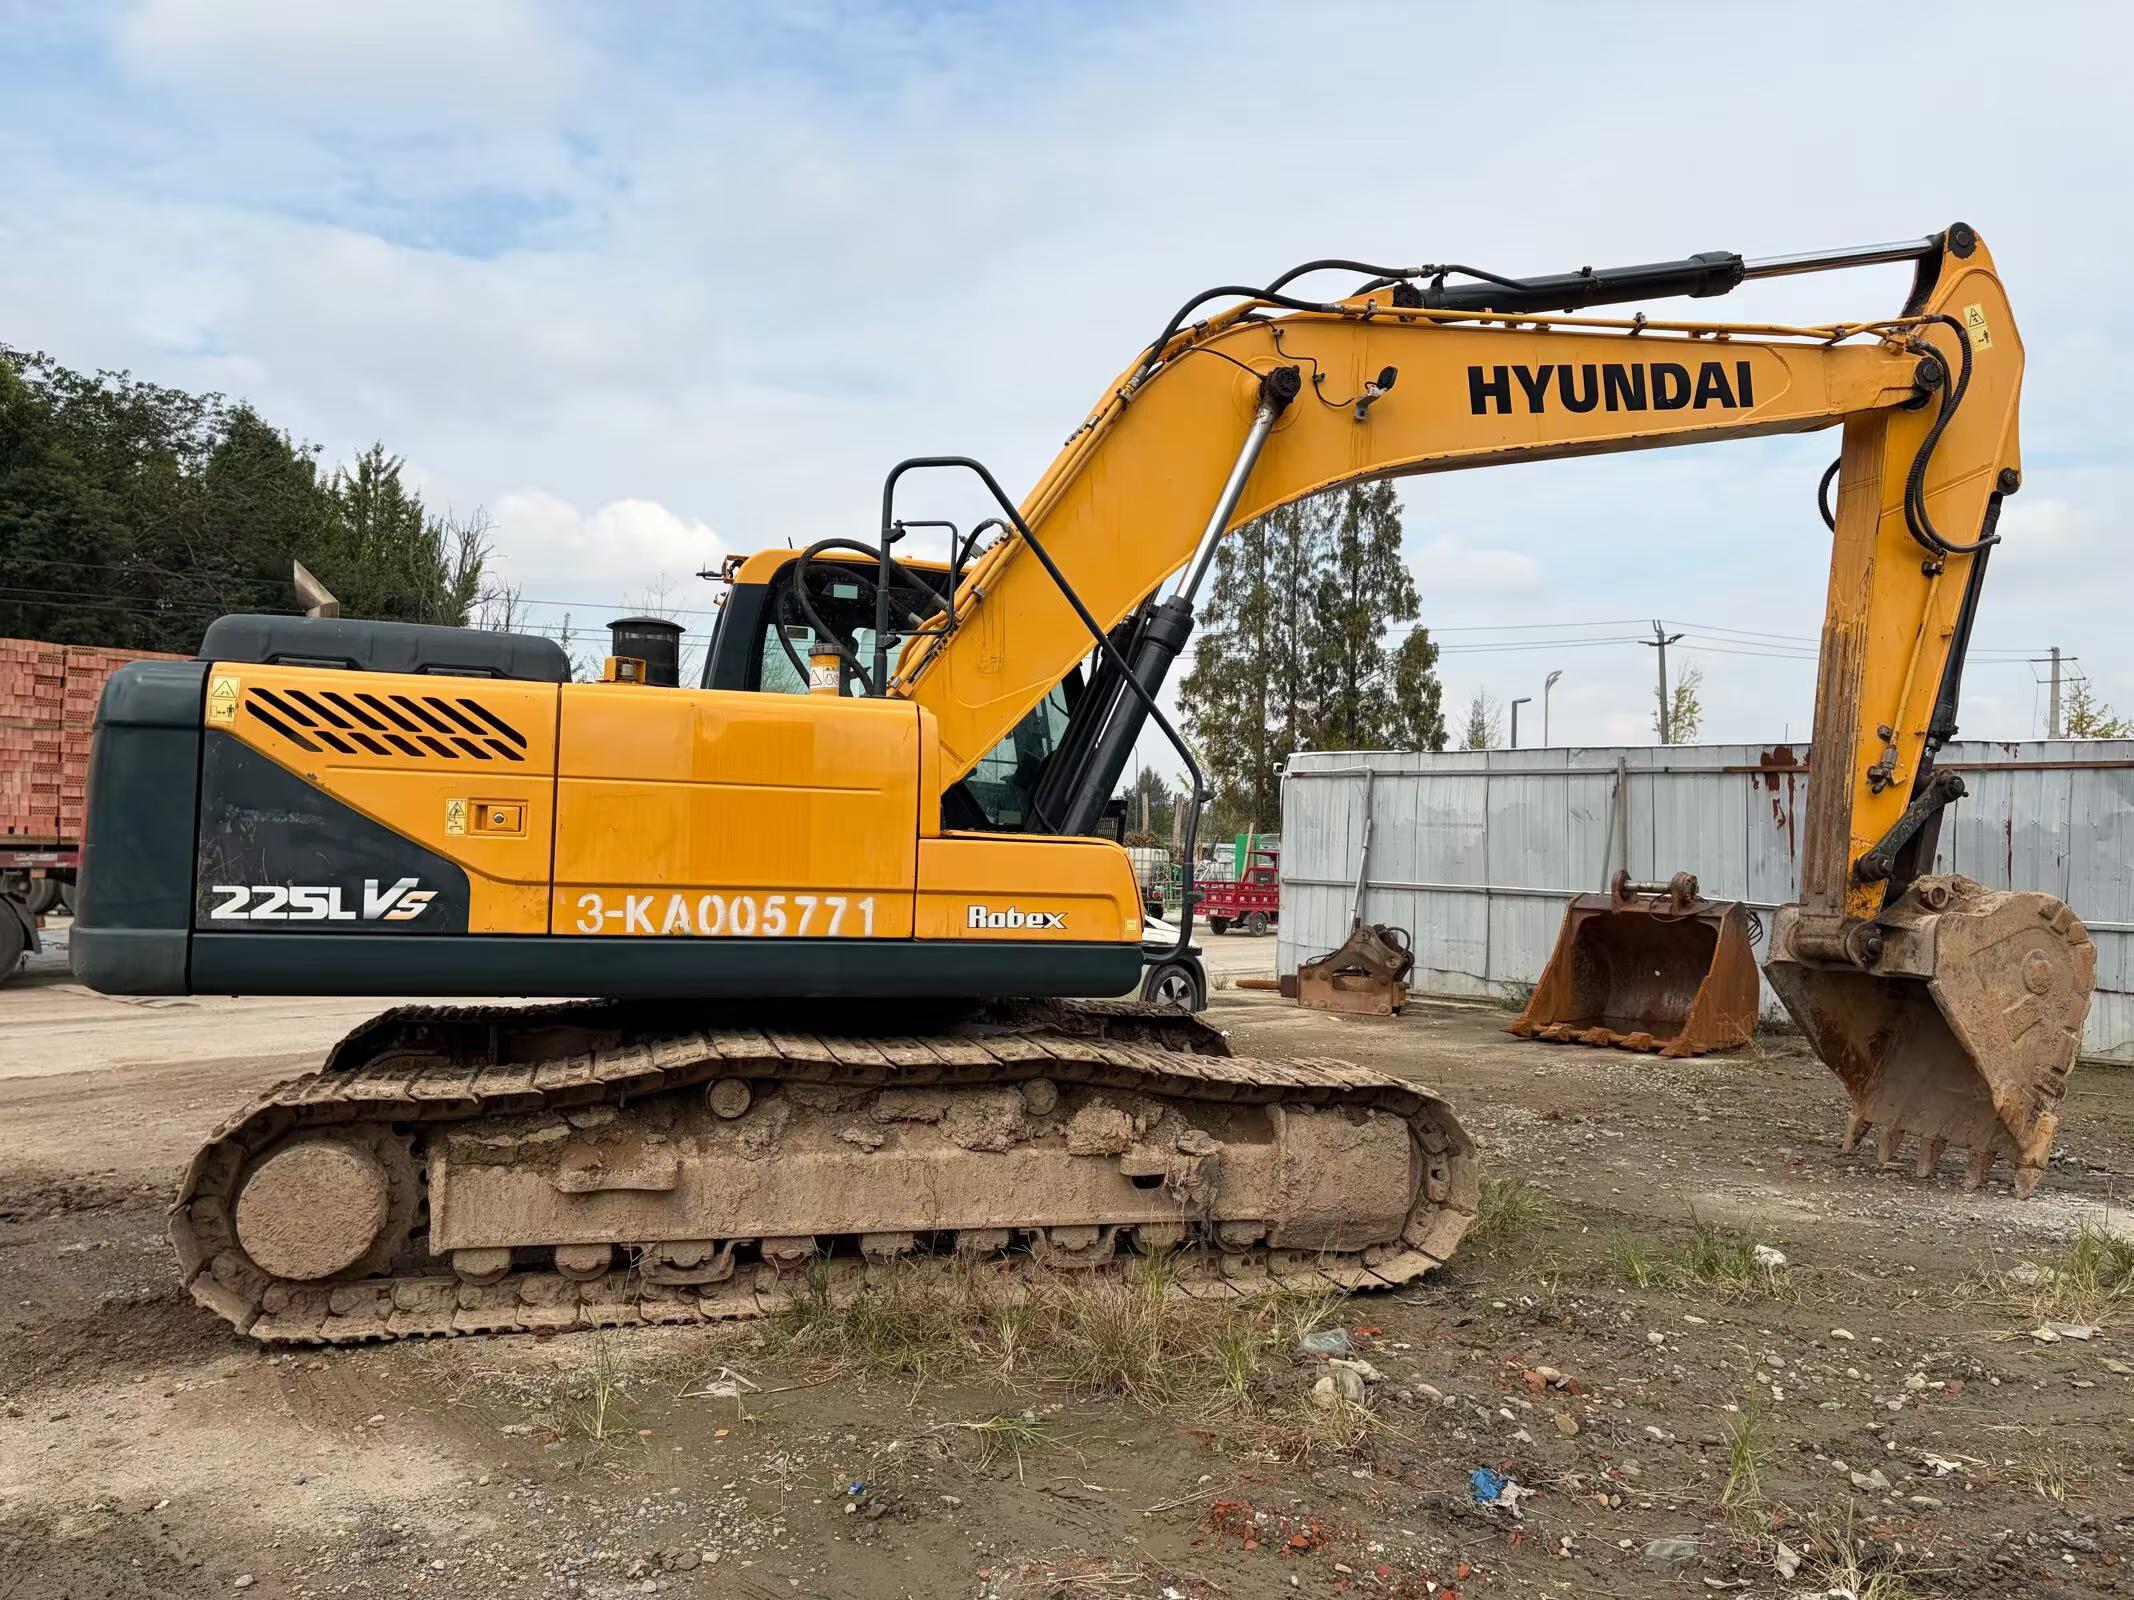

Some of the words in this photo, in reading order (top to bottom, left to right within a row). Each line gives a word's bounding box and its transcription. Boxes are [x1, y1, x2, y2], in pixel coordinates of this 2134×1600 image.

[1467, 360, 1754, 415] HYUNDAI
[576, 893, 875, 937] 3-KA005771
[967, 904, 1069, 930] Robex
